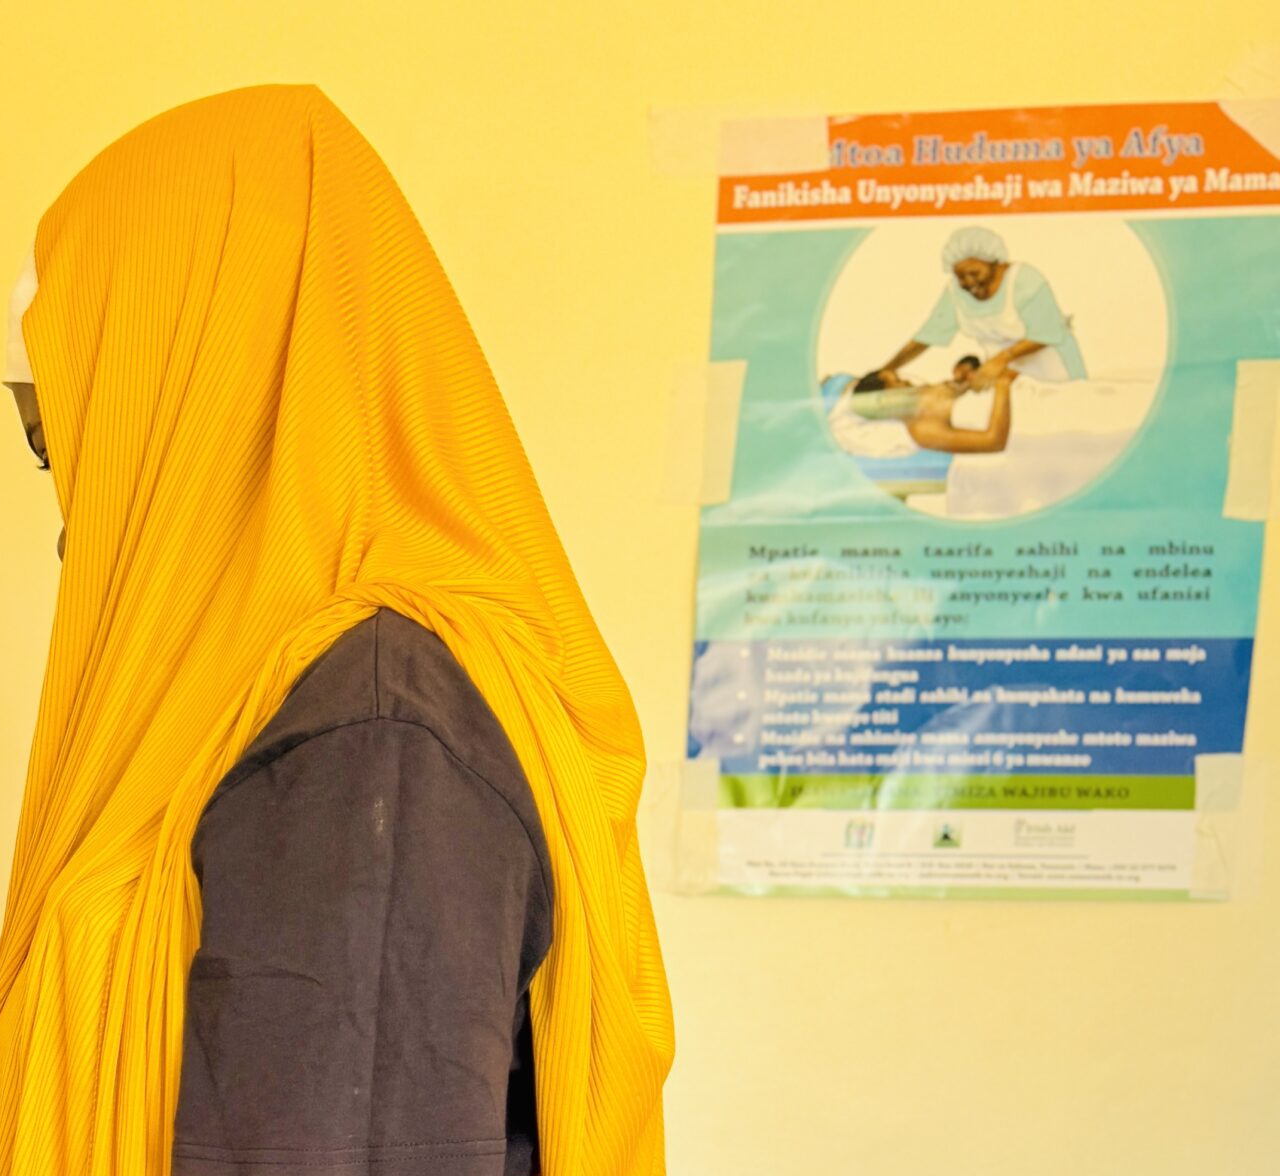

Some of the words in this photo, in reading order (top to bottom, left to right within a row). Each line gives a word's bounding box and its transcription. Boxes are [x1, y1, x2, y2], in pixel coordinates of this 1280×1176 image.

[912, 131, 1064, 166] Huduma
[1072, 136, 1113, 168] ya
[1121, 124, 1204, 166] Afya
[732, 179, 851, 209] Fanikisha
[857, 174, 1022, 209] Unyonyeshaji
[1027, 178, 1063, 199] wa
[1069, 170, 1163, 197] Maziwa
[1169, 173, 1198, 202] ya
[1204, 167, 1280, 193] Mama
[749, 544, 819, 562] Mpatie
[841, 546, 902, 558] mama
[924, 543, 993, 558] taarifa
[1016, 542, 1078, 557] sahihi
[1102, 544, 1125, 556] na
[1149, 540, 1214, 556] mbinu
[930, 565, 1065, 582] unyonyeshaji
[1088, 567, 1111, 579] na
[1133, 563, 1212, 579] endelea
[948, 586, 1068, 606] anyonyeshe
[1083, 586, 1123, 601] kwa
[1137, 586, 1210, 601] ufanisi
[937, 786, 997, 799] MIZA
[1003, 787, 1069, 799] WAJIBU
[1076, 787, 1130, 799] WAKO
